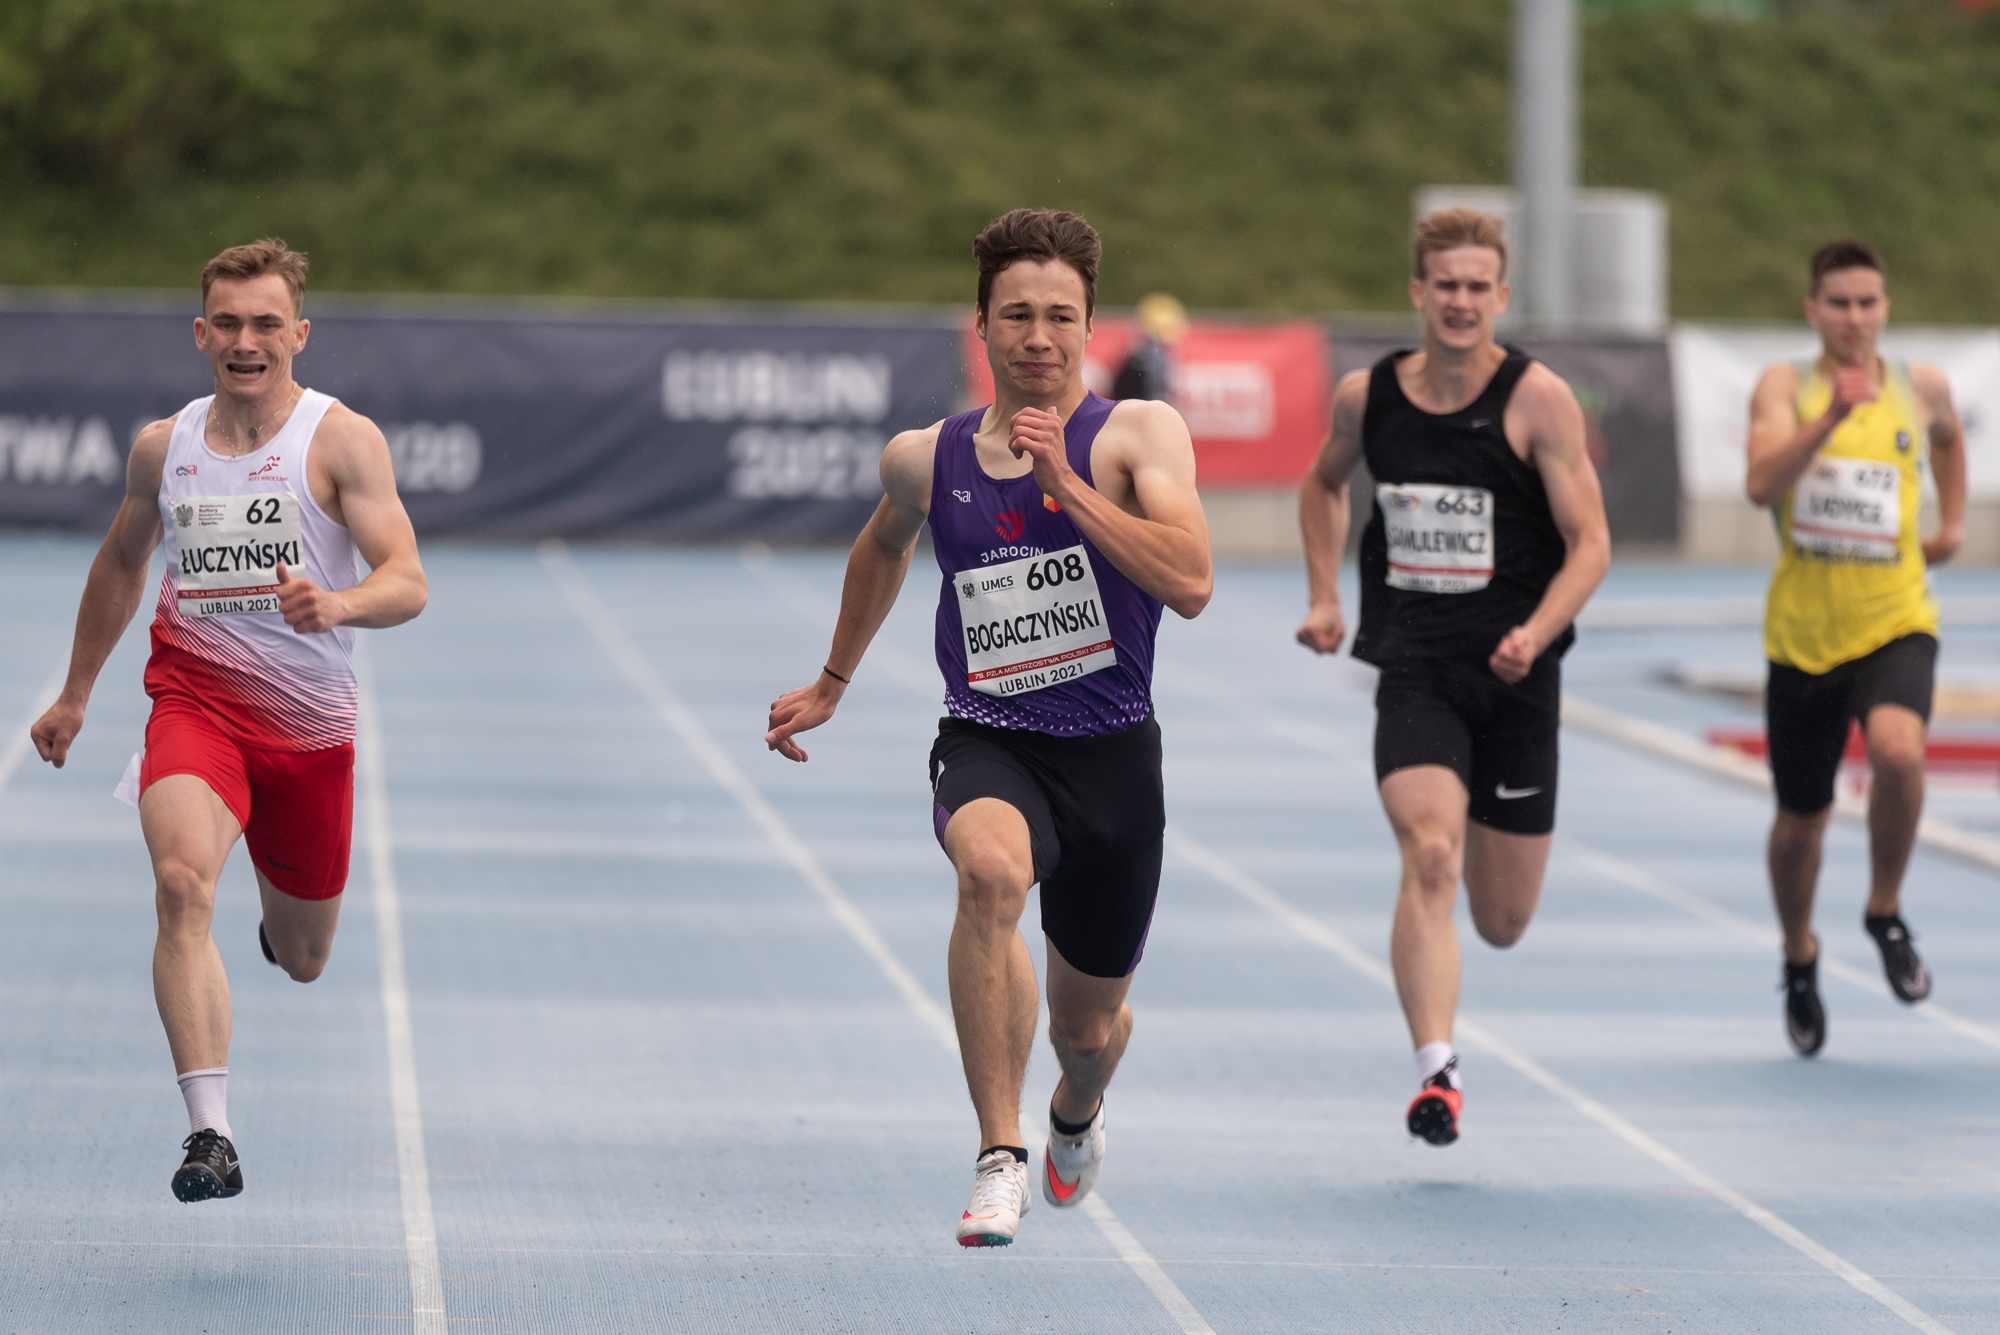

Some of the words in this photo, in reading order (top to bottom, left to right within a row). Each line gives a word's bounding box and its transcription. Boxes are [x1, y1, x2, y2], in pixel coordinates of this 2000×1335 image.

[662, 352, 890, 422] LUBLIN
[246, 498, 282, 525] 62
[1436, 492, 1484, 516] 663
[181, 539, 299, 574] ŁUCZYŃSKI
[980, 546, 1044, 563] JAROCIN
[981, 575, 1014, 591] UMCS
[1026, 553, 1085, 591] 608
[200, 601, 243, 615] LUBLIN
[247, 598, 278, 612] 2021
[206, 587, 258, 597] MISTRZOSTWA
[966, 599, 1100, 654] BOGACZYŃSKI
[986, 669, 1004, 678] PZLA
[1004, 657, 1060, 675] MISTRZOSTWA
[1060, 649, 1090, 662] POLSKI
[1090, 643, 1107, 653] U20
[999, 673, 1047, 694] LUBLIN
[1050, 662, 1084, 683] 2021
